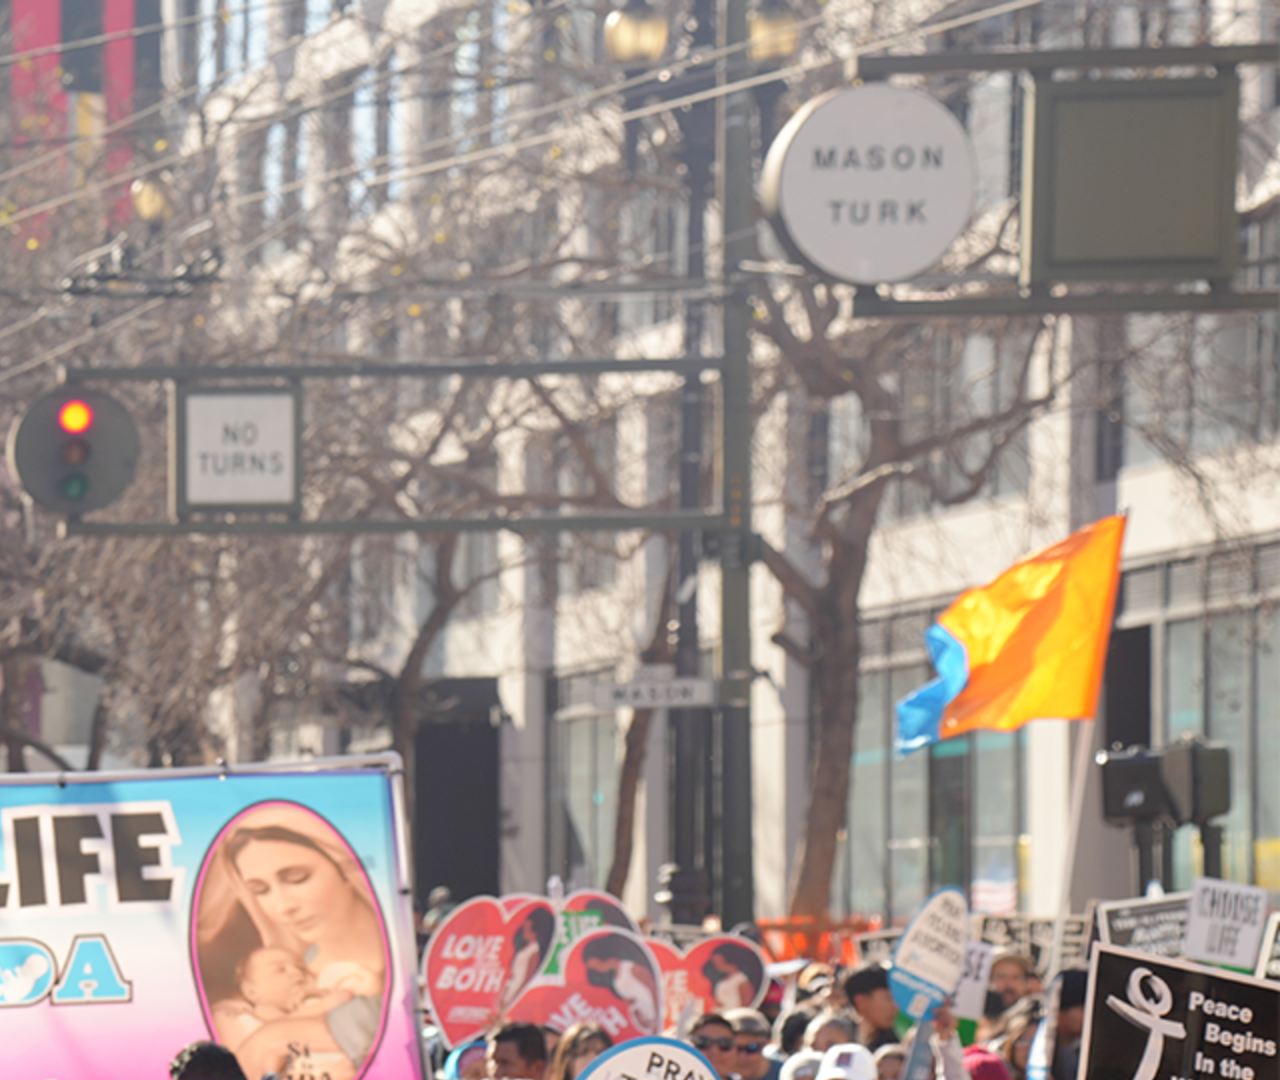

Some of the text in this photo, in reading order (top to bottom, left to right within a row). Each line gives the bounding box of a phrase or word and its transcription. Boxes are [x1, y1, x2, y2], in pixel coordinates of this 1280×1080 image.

[811, 146, 946, 172] MASON
[828, 200, 929, 226] TURK
[221, 420, 260, 448] NO
[197, 450, 284, 477] TURNS
[441, 933, 505, 960] LOVE
[434, 964, 506, 994] BOTH
[1188, 990, 1254, 1024] Peace
[1204, 1021, 1278, 1057] Begins
[1194, 1051, 1216, 1075] In
